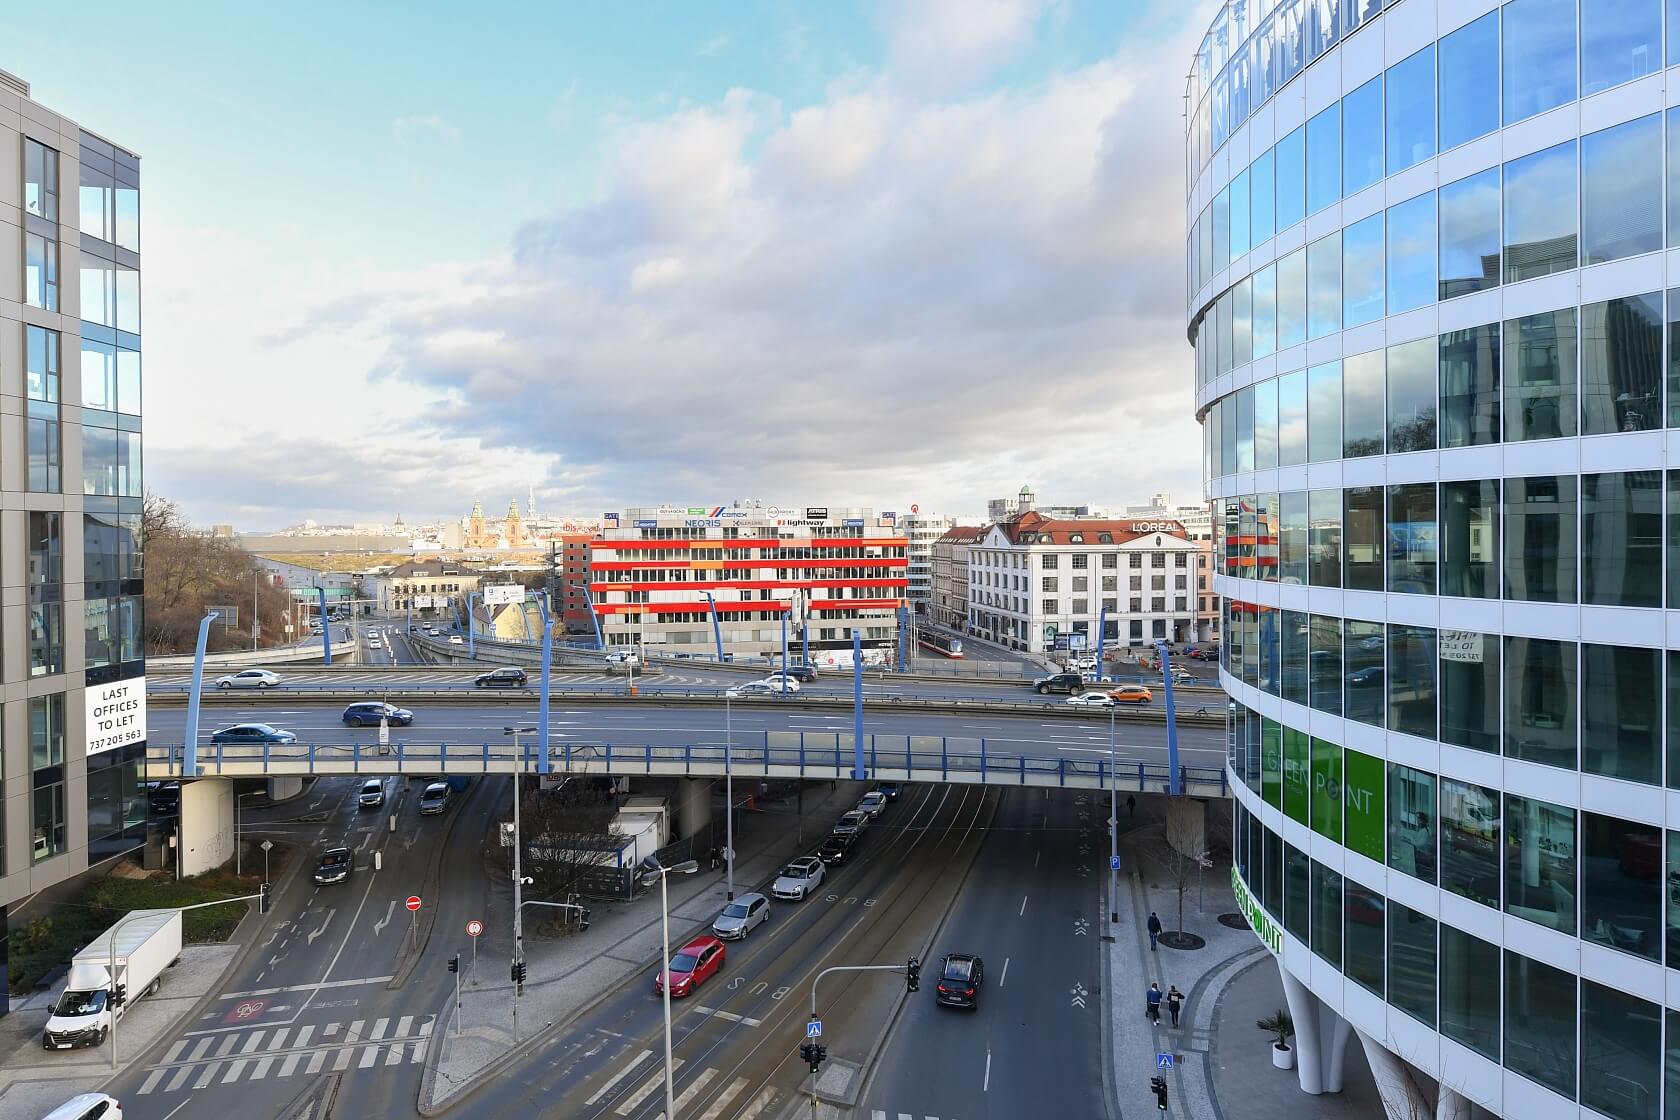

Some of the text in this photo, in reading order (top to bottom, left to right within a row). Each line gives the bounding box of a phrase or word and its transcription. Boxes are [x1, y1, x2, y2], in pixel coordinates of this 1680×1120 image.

[685, 519, 721, 528] NEORIS
[787, 518, 825, 528] lightway
[103, 687, 128, 700] LAST
[94, 700, 138, 717] OFFICES
[98, 715, 134, 731] TO LET
[90, 730, 140, 750] 737 205 563
[727, 977, 791, 1000] BUS
